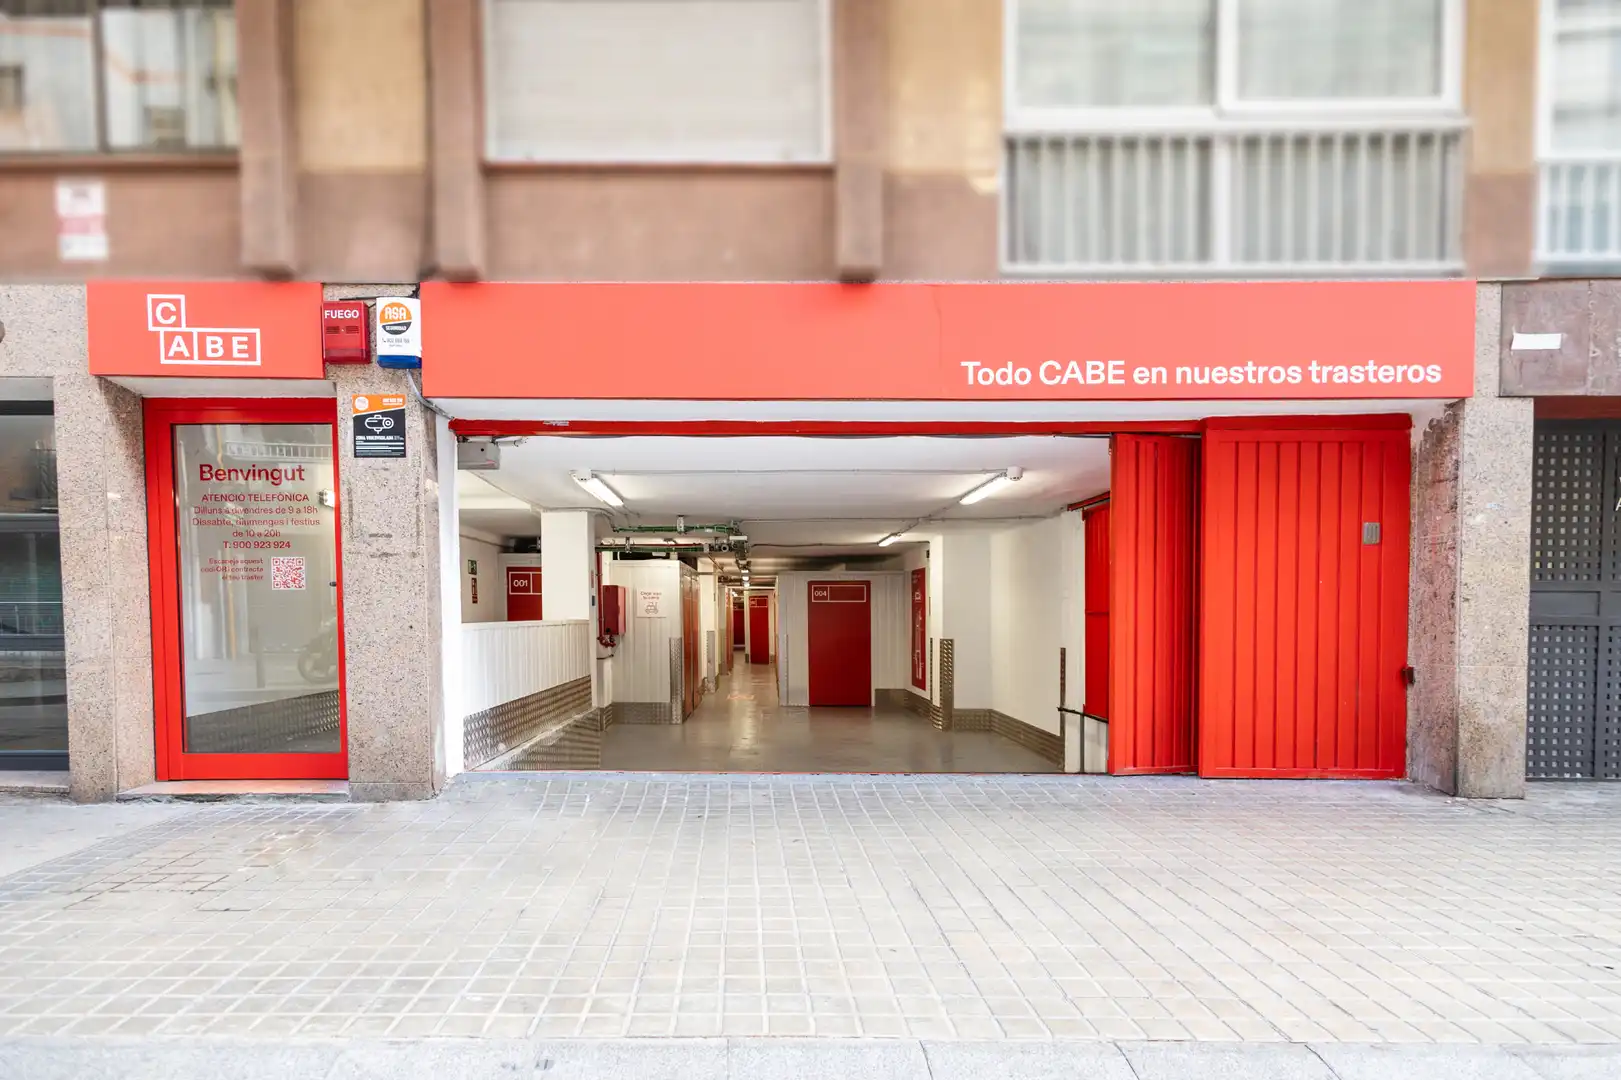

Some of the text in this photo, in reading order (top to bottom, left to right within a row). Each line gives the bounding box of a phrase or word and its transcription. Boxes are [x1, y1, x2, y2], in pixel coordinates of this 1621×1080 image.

[324, 309, 359, 319] FUEGO
[384, 306, 407, 320] ASA
[961, 360, 1442, 386] Todo CABE en nuestros trasteros
[199, 463, 305, 486] Benvingut
[201, 492, 246, 502] ATENCIÓ
[194, 506, 223, 514] Dilluns
[232, 506, 273, 514] divendres
[275, 506, 286, 514] de
[288, 506, 294, 514] 9
[304, 506, 318, 514] 18h
[192, 518, 234, 527] Dissabte,
[236, 518, 284, 527] diumenges
[232, 530, 244, 538] de
[246, 530, 255, 538] 10
[264, 530, 280, 538] 20h
[233, 541, 251, 549] 900
[254, 541, 271, 549] 923
[273, 541, 291, 549] 924
[513, 579, 528, 588] 001
